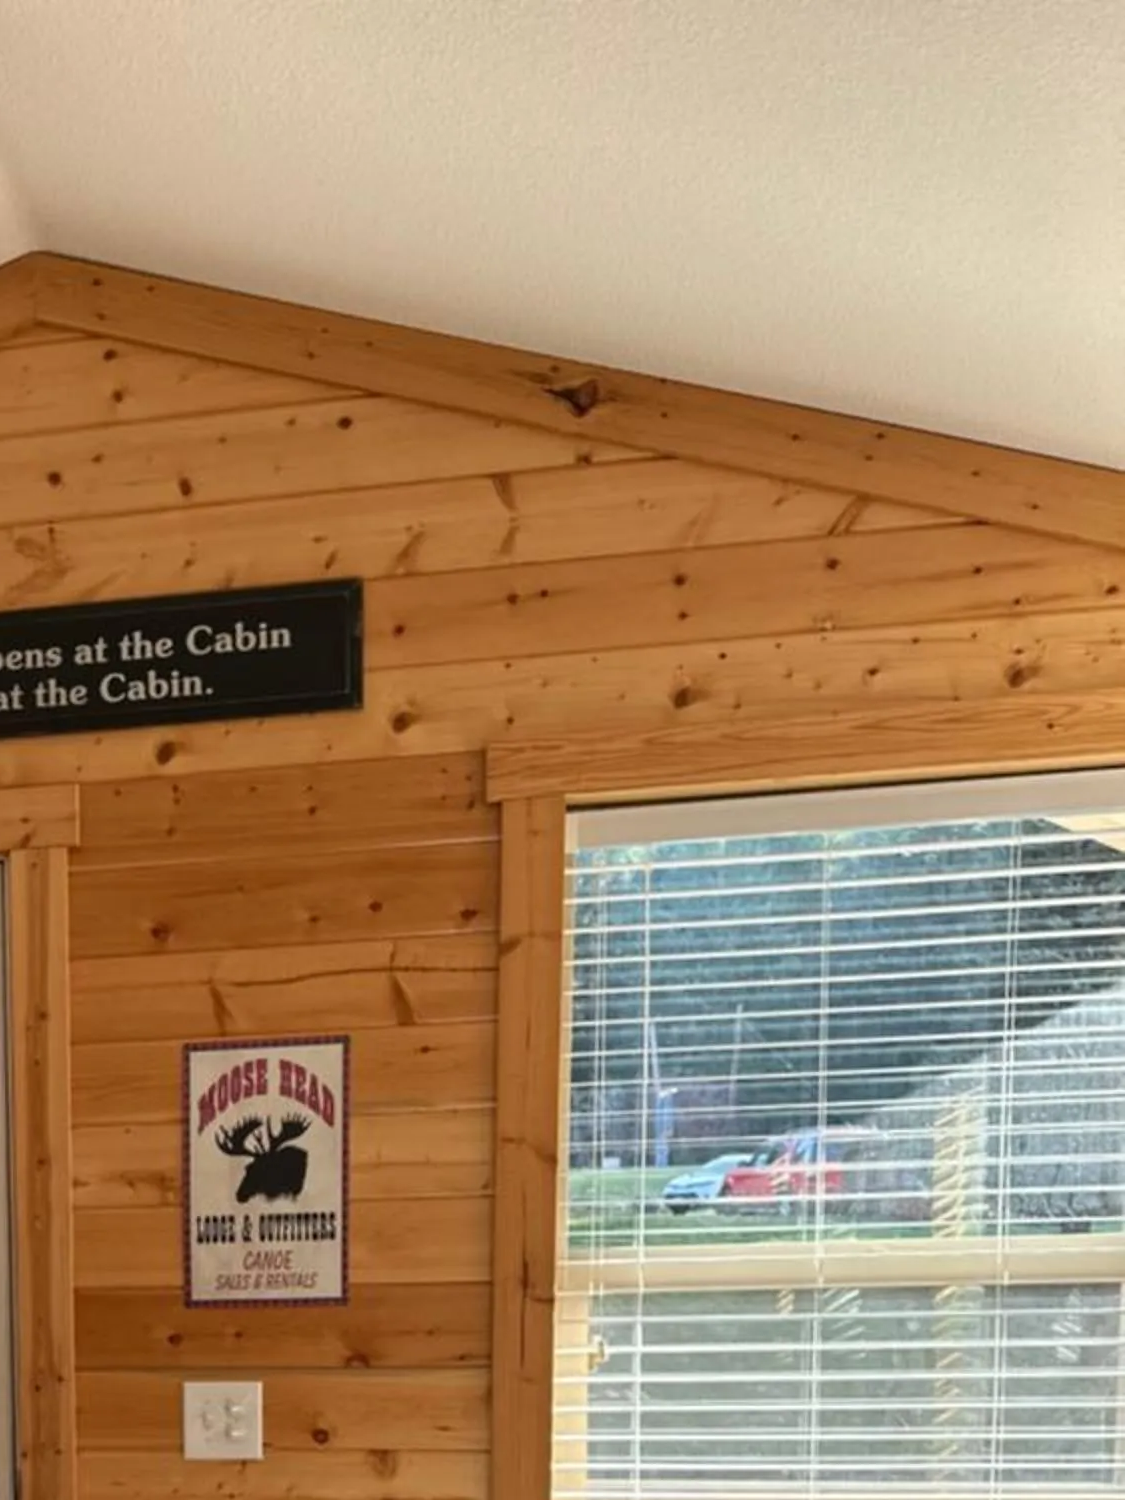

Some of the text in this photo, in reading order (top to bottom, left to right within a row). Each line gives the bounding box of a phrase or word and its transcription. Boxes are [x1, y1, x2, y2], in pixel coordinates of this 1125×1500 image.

[74, 637, 107, 664] at
[119, 631, 173, 661] the
[185, 622, 292, 656] Cabin
[35, 678, 88, 708] the
[100, 669, 213, 703] Cabin.
[197, 1058, 335, 1136] MOOSE HEAD
[196, 1212, 336, 1244] LODGE & OUTFITTERS
[242, 1250, 294, 1271] CANOE
[215, 1272, 318, 1291] SALES & RENTALS
